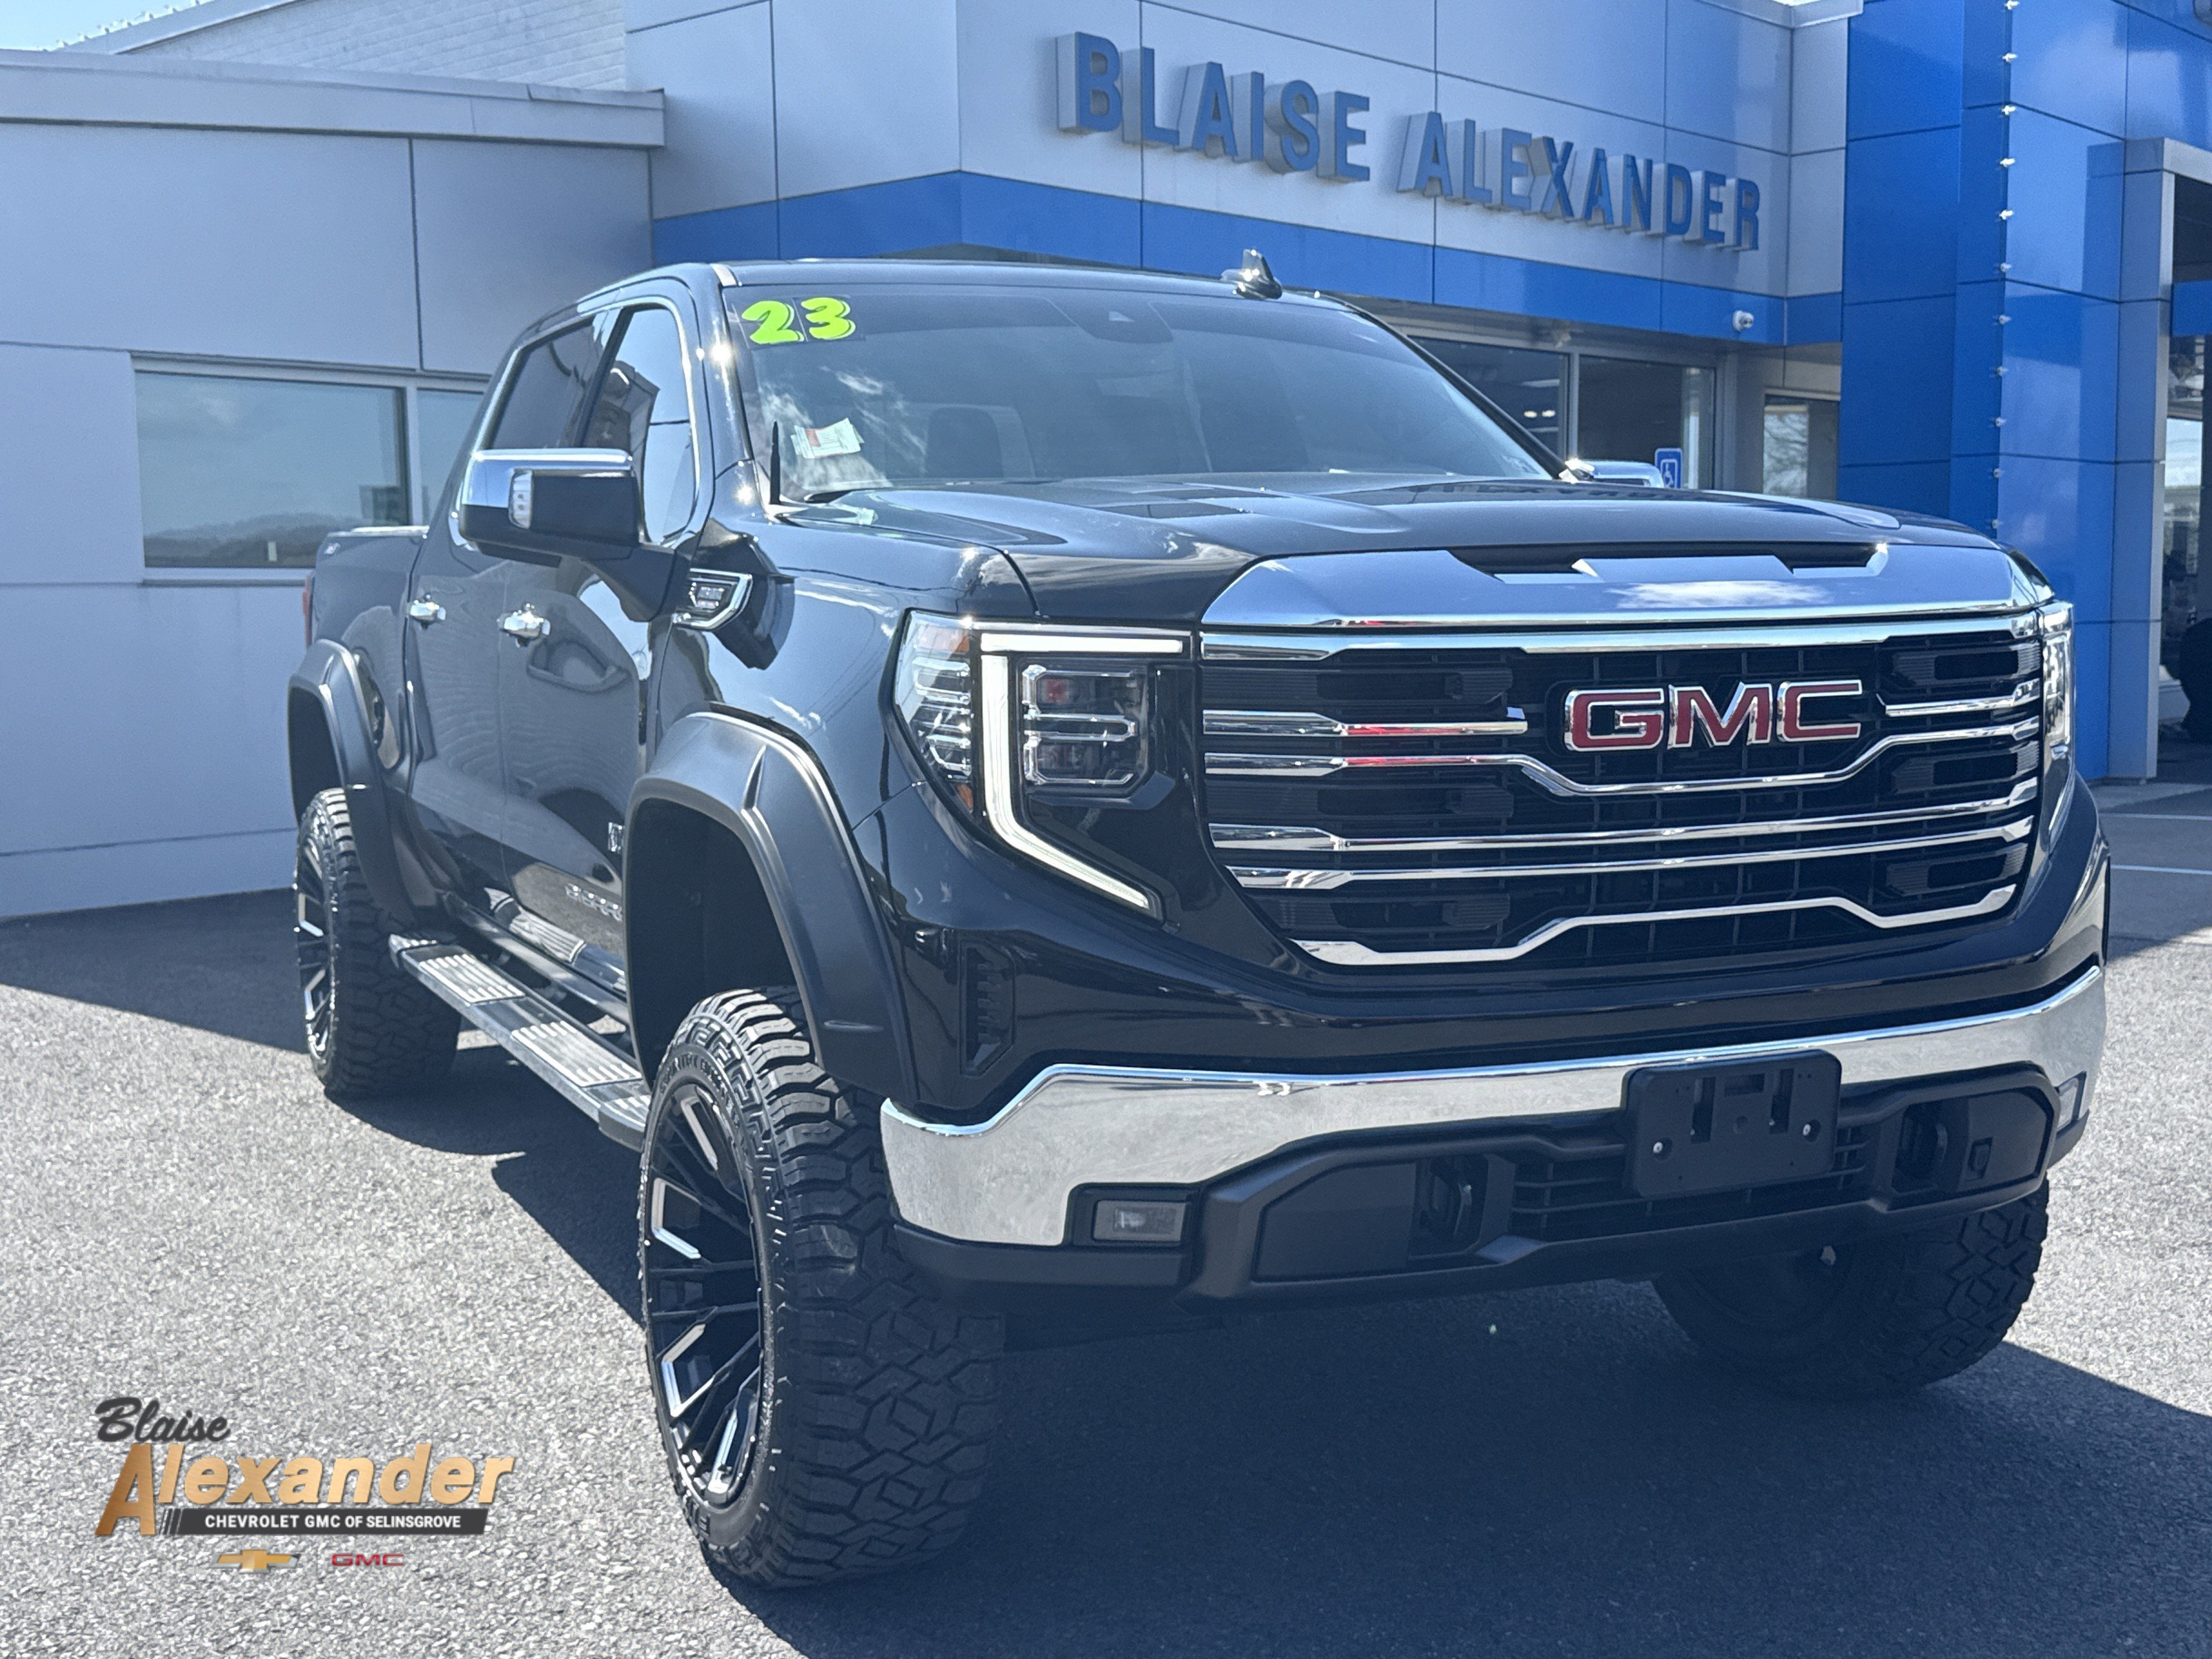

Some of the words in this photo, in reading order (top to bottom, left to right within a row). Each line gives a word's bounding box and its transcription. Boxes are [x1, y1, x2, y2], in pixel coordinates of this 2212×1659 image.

[1062, 31, 1370, 182] BLAISE
[1399, 111, 1760, 252] ALEXANDER
[741, 296, 856, 345] 23
[1565, 680, 1863, 752] GMC
